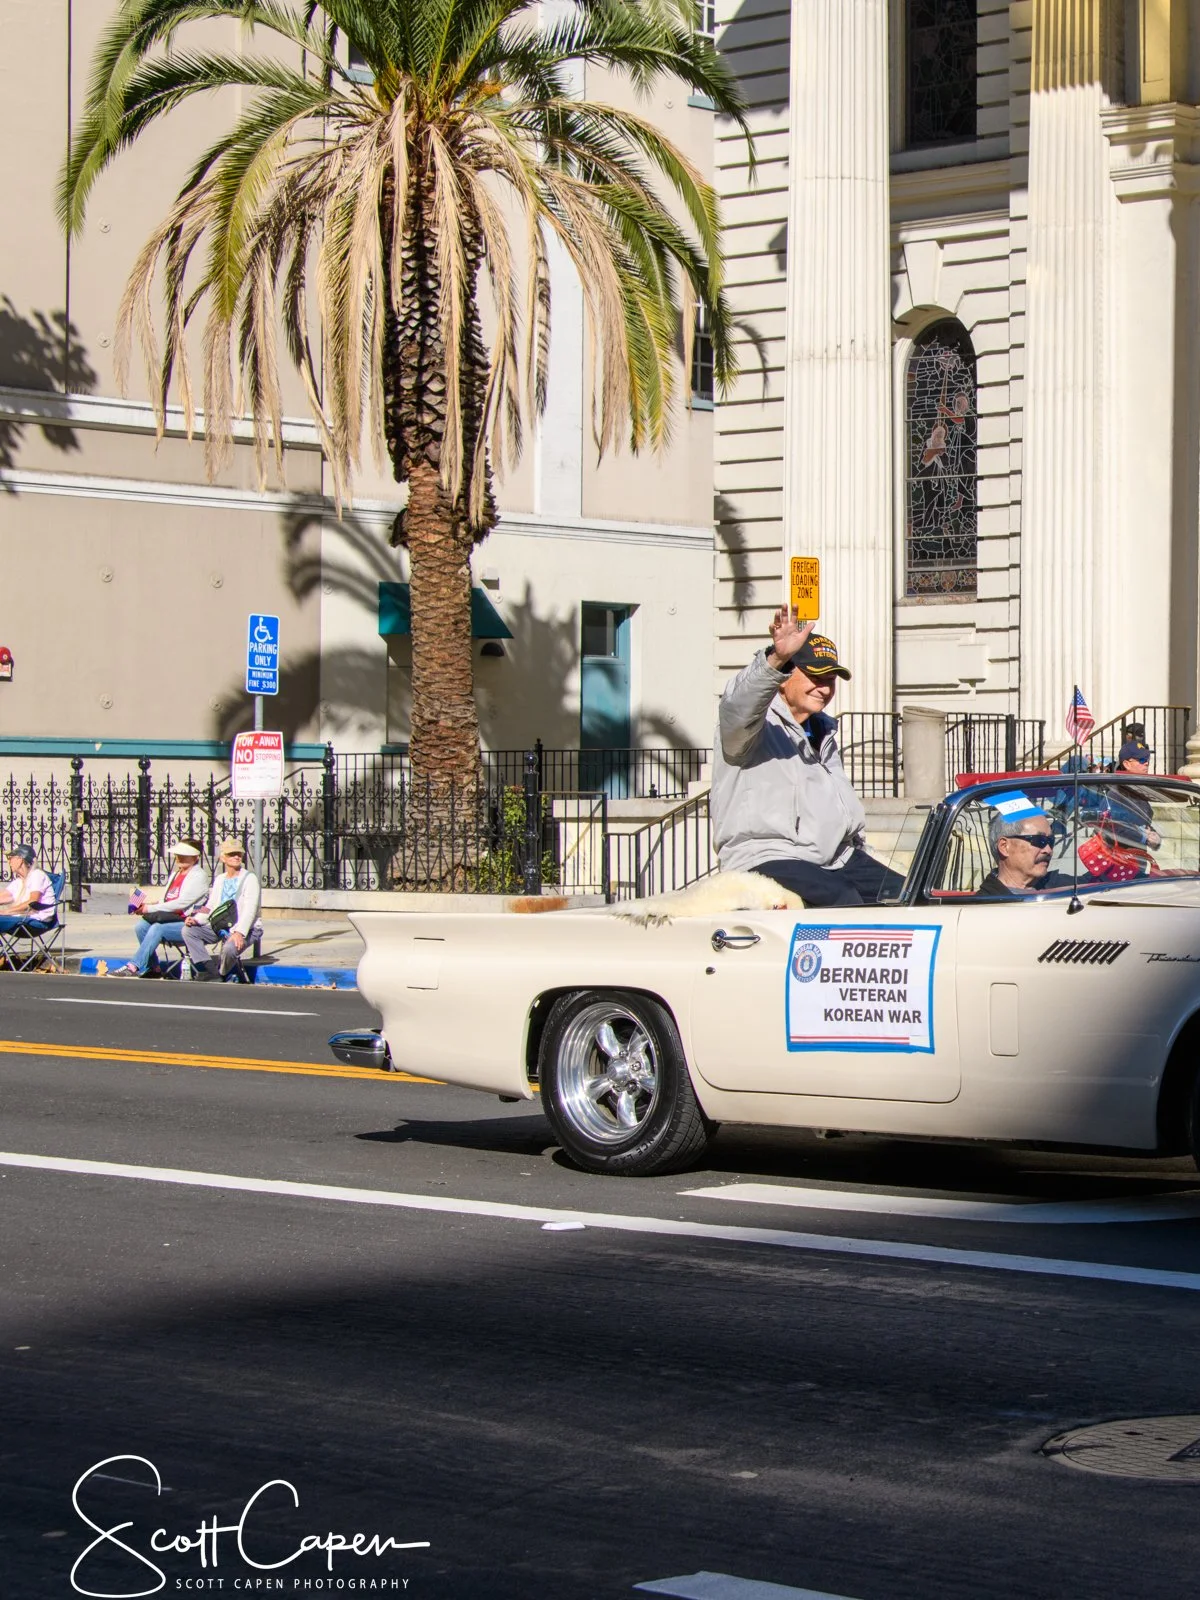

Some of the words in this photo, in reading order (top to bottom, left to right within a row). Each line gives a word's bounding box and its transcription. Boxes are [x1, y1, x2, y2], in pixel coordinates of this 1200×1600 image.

[793, 561, 818, 574] FREIGHT
[792, 574, 818, 587] LOADING
[797, 587, 813, 598] ZONE
[249, 642, 277, 655] PARKING
[254, 655, 272, 667] ONLY
[251, 670, 274, 679] MINIMUM
[248, 679, 260, 688] FINE
[259, 735, 280, 747] AWAY
[236, 749, 253, 763] NO
[255, 753, 281, 761] STOPPING
[841, 942, 912, 959] ROBERT
[819, 967, 908, 985] BERNARDI
[839, 988, 907, 1003] VETERAN
[823, 1008, 884, 1023] KOREAN
[888, 1010, 922, 1024] WAR
